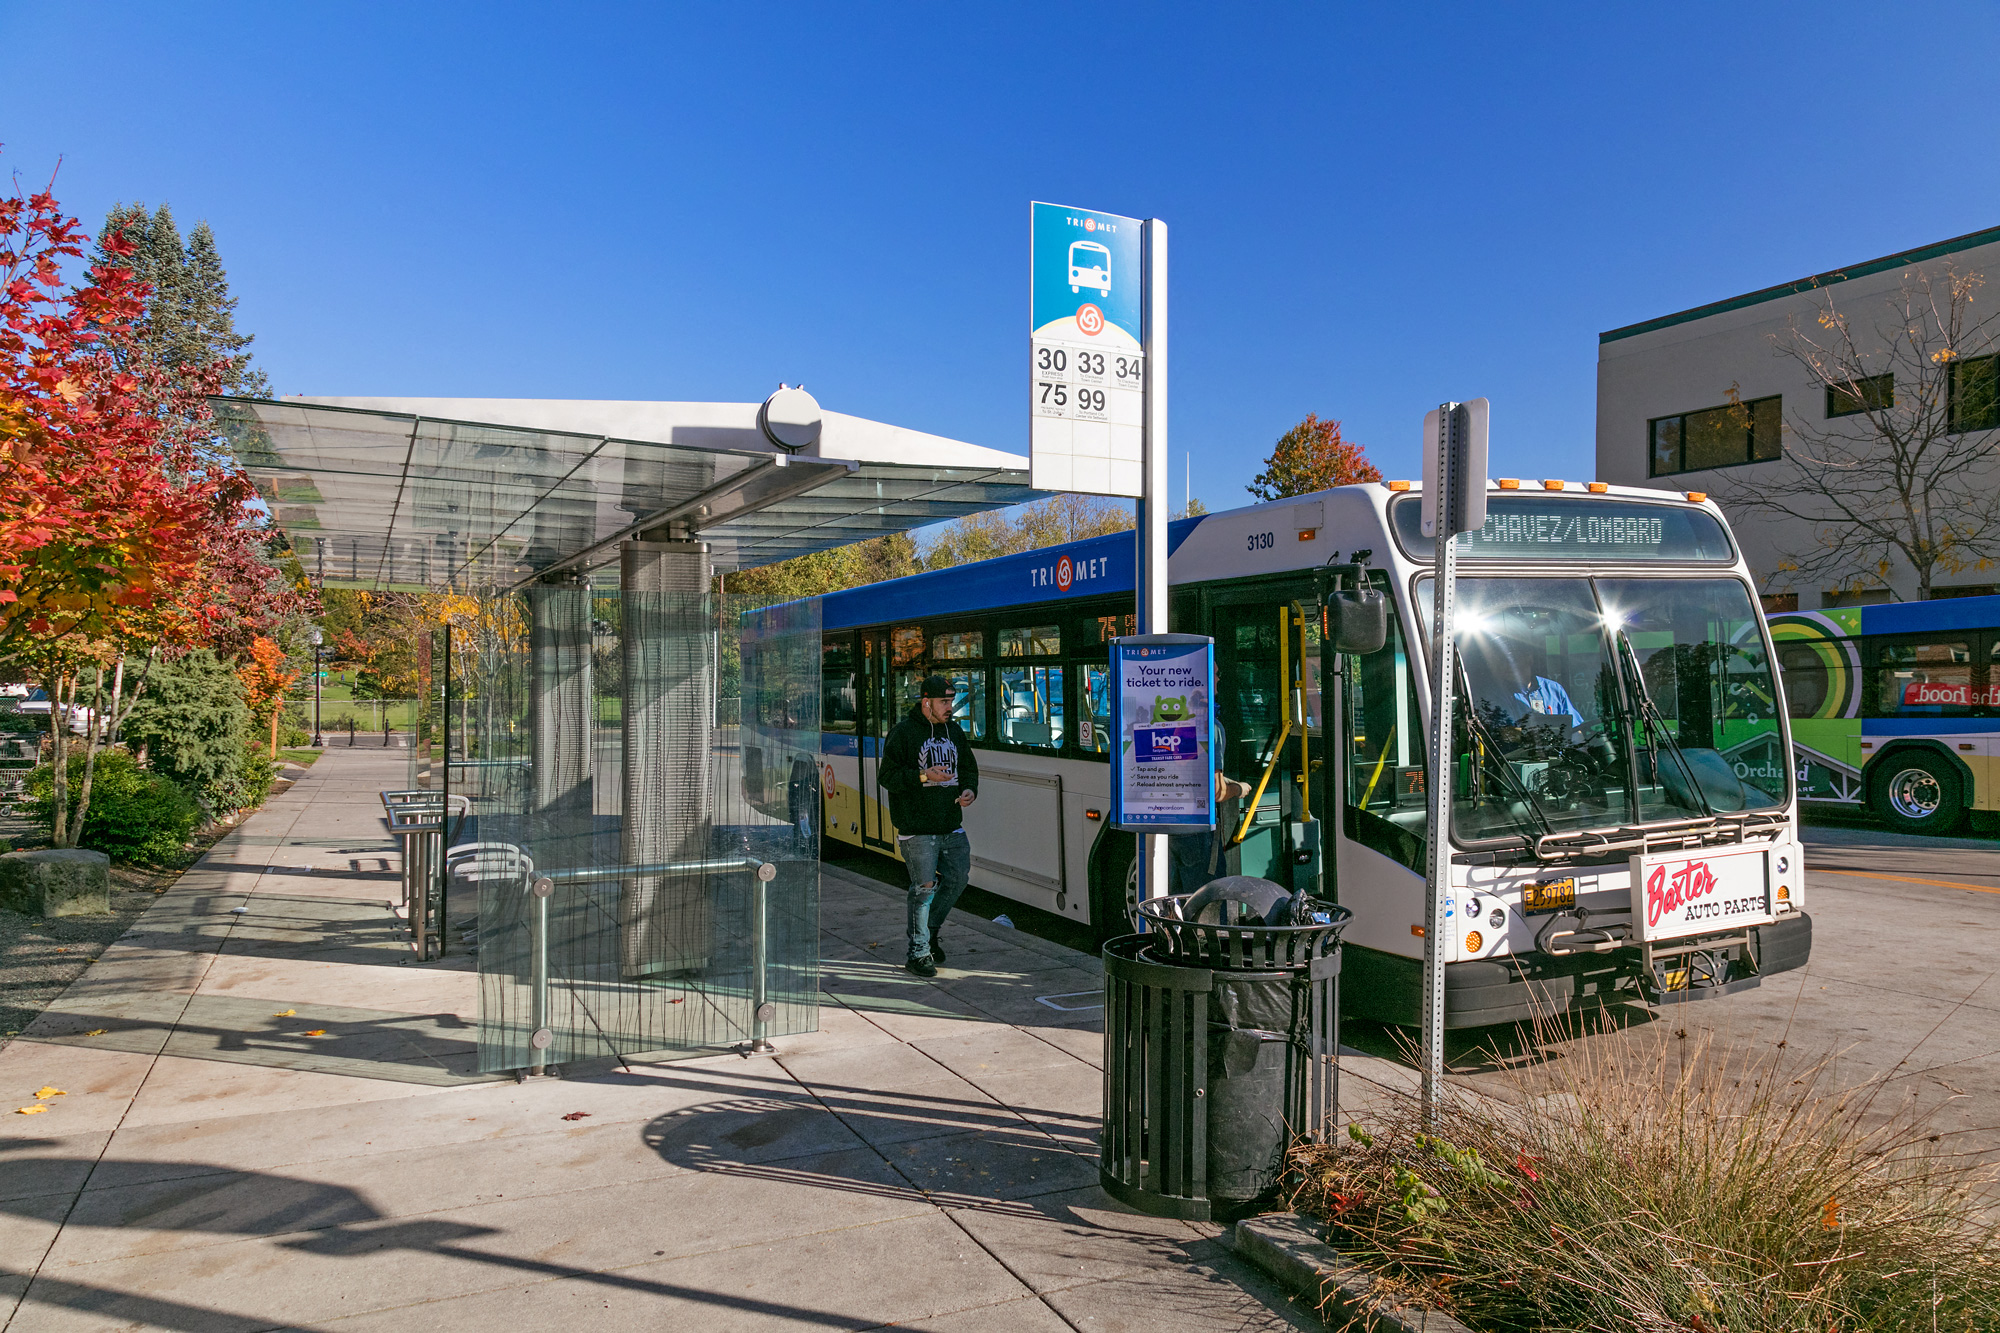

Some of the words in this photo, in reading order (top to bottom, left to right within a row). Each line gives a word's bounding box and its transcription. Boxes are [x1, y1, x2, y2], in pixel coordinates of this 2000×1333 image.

[1066, 217, 1083, 227] TRI
[1097, 222, 1117, 233] MET
[1038, 348, 1067, 371] 30
[1078, 352, 1105, 375] 33
[1116, 357, 1141, 380] 34
[1039, 382, 1067, 406] 75
[1078, 388, 1106, 411] 99
[1247, 532, 1274, 551] 3130
[1031, 566, 1053, 587] TRI
[1076, 557, 1108, 581] MET
[1098, 616, 1117, 641] 75
[1126, 677, 1161, 687] ticket
[1163, 678, 1176, 687] to
[1178, 677, 1204, 687] ride.
[1138, 666, 1165, 675] Your
[1168, 667, 1192, 675] new
[1152, 732, 1181, 751] hop
[1733, 762, 1809, 782] Orchad
[1526, 886, 1573, 906] E259782
[1647, 860, 1718, 927] Baxter
[1685, 902, 1720, 921] AUTO
[1724, 896, 1765, 915] PARTS
